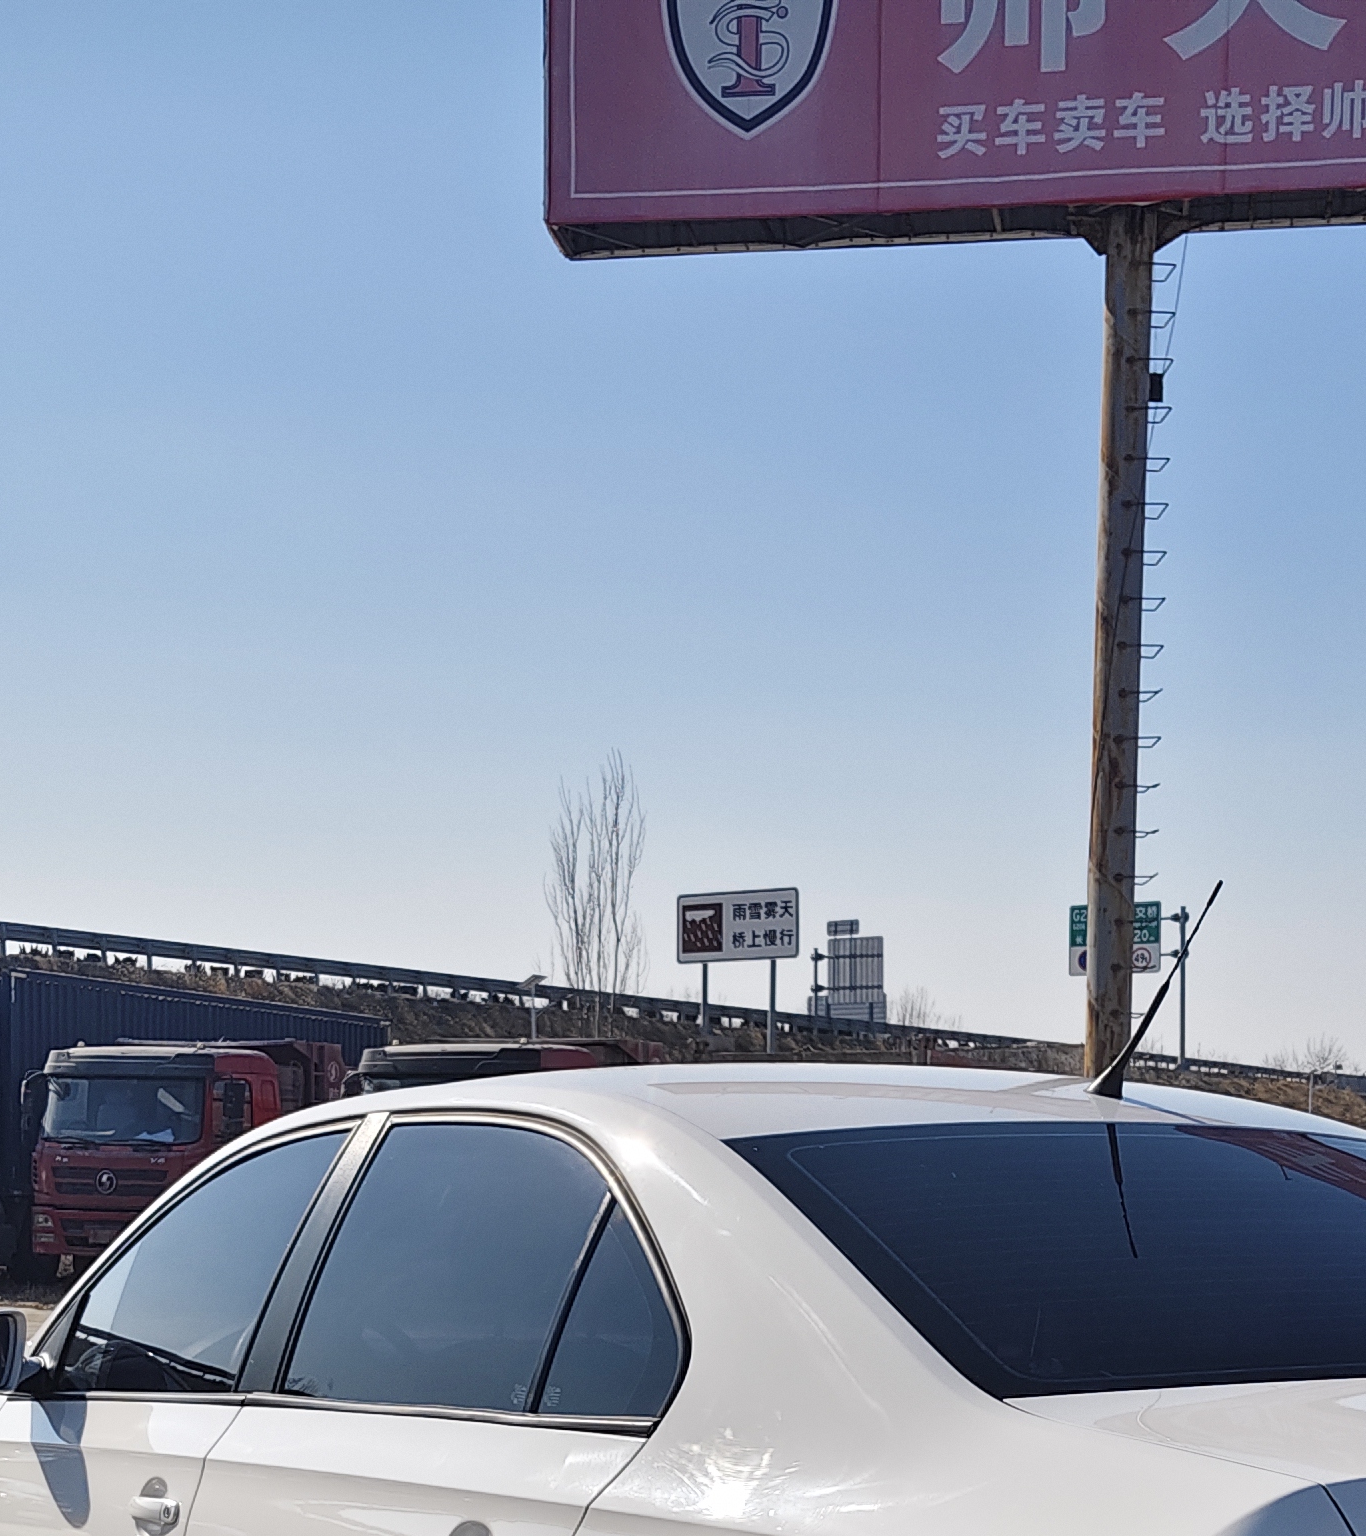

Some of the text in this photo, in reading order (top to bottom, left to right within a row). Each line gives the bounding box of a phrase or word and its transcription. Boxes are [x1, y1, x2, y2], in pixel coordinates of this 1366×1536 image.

[937, 92, 1166, 158] 买车卖车
[732, 900, 794, 921] 雨雪雾天
[732, 929, 794, 948] 桥上慢行
